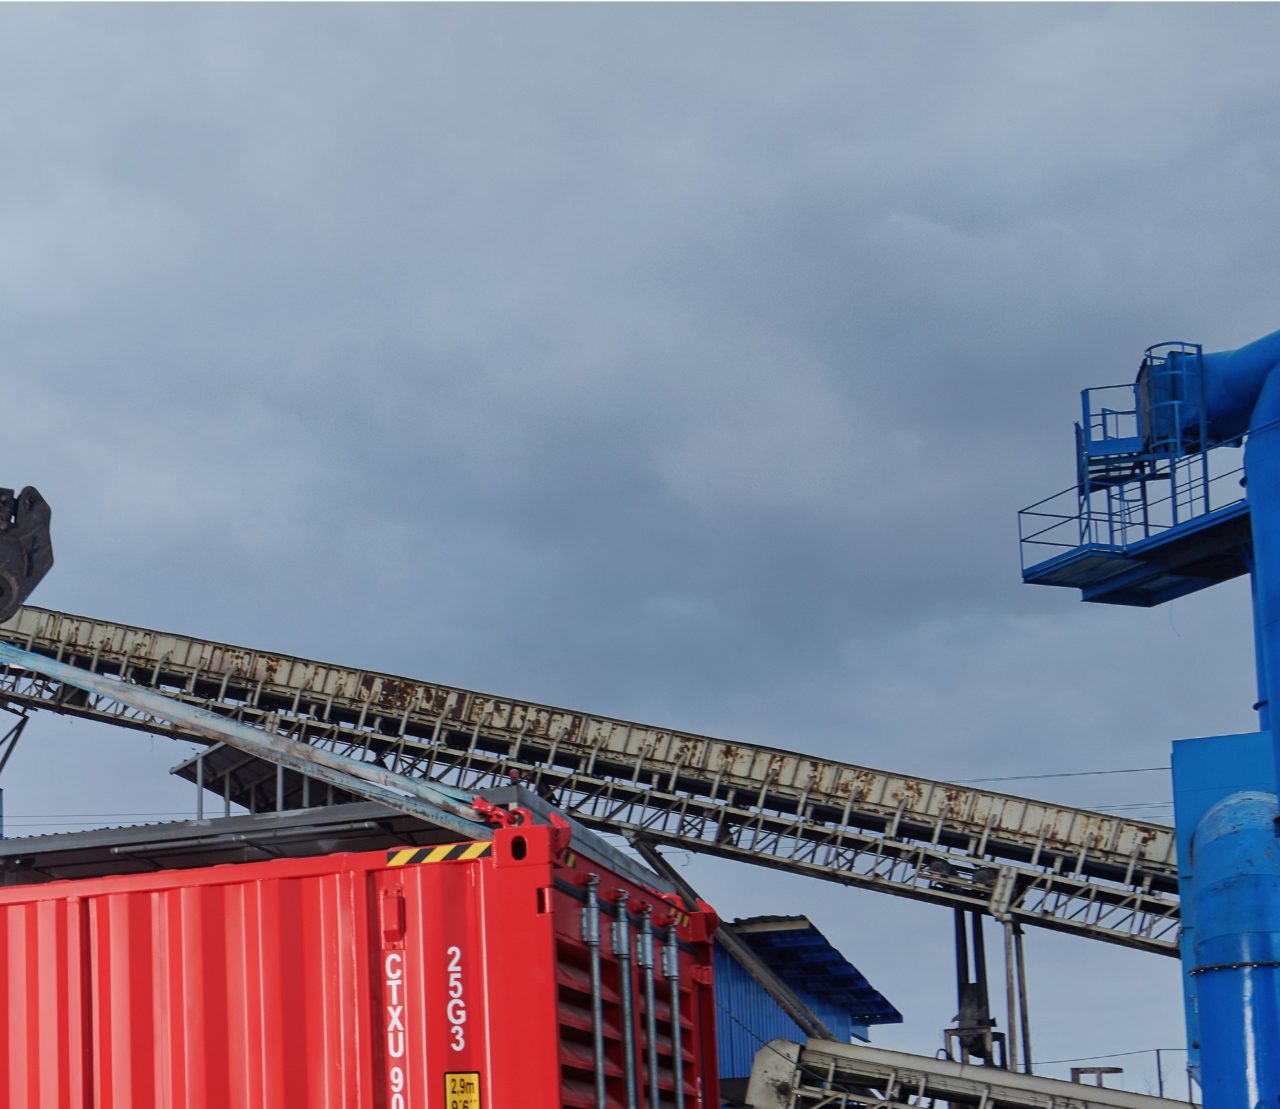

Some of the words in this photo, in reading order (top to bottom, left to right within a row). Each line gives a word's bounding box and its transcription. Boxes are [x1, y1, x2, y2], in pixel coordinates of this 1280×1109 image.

[385, 953, 405, 1058] CTXU
[446, 946, 467, 1052] 25G3
[451, 1078, 475, 1097] 2,9m
